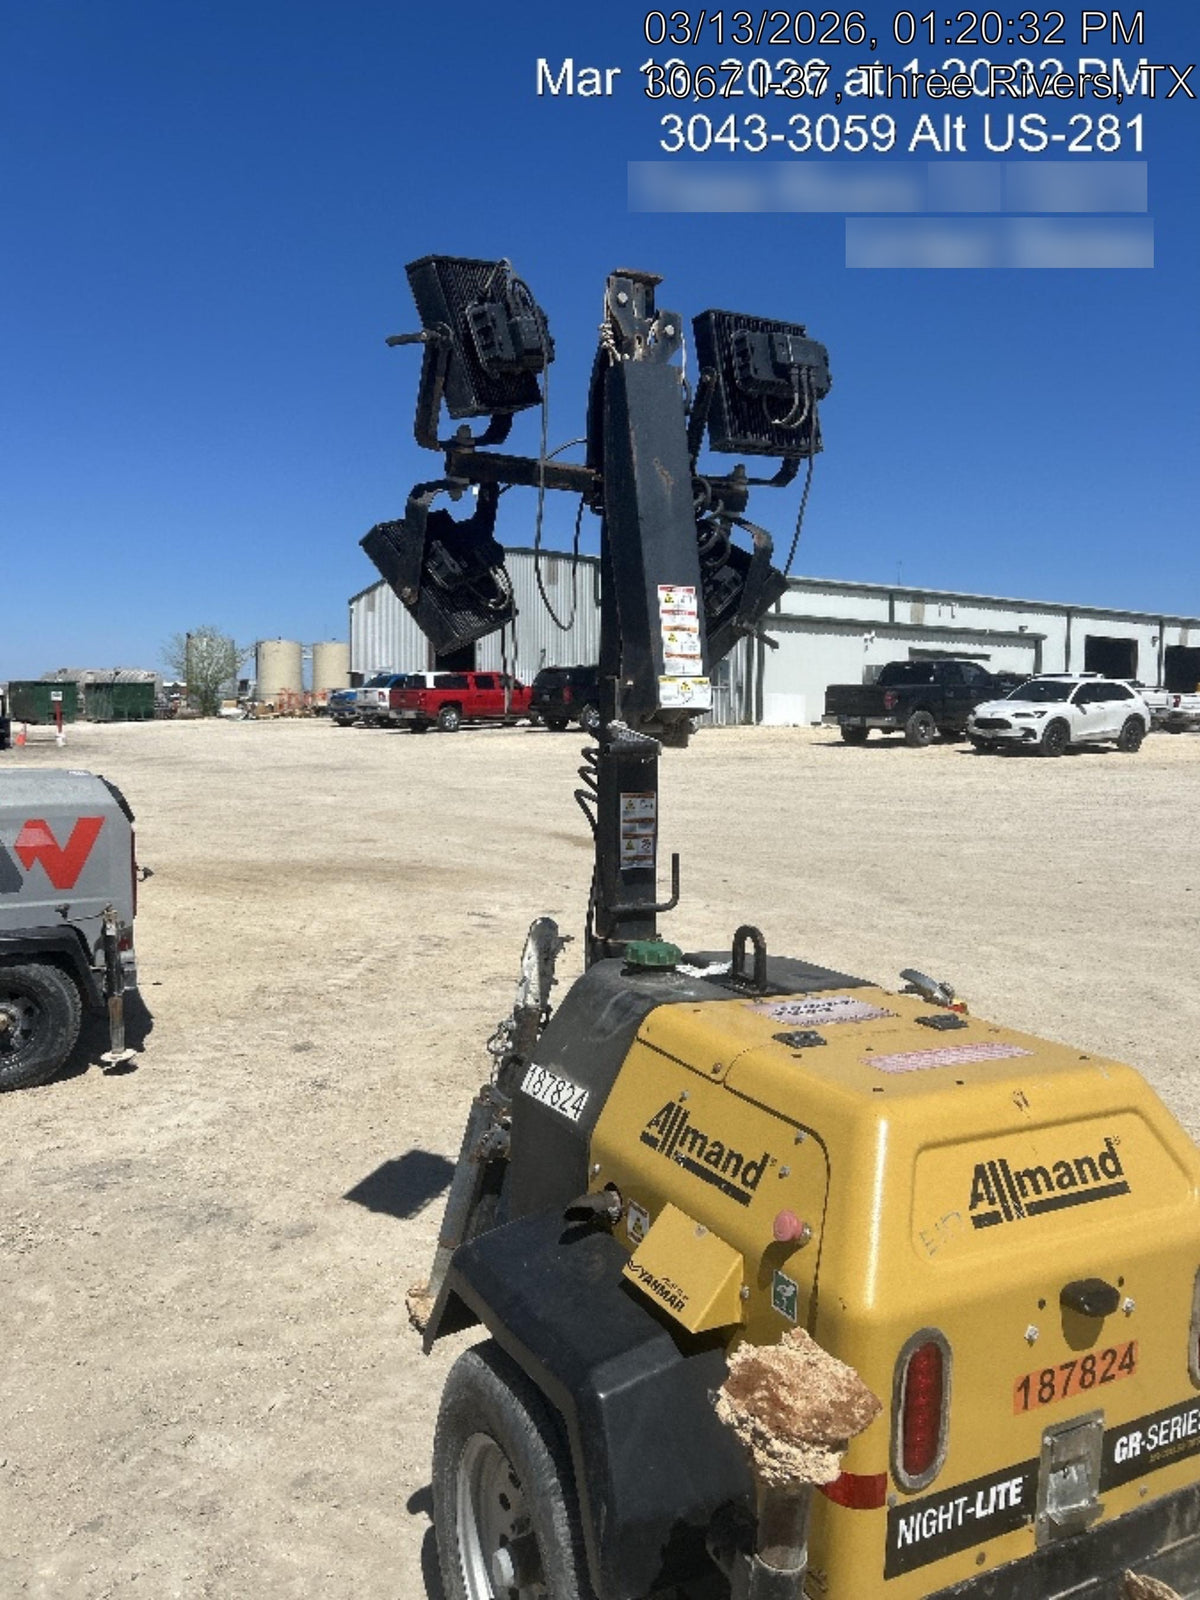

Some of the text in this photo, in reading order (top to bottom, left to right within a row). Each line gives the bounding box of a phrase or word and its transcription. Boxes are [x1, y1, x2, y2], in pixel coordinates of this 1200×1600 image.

[524, 1064, 589, 1120] 187824
[644, 1099, 771, 1193] Allmand
[968, 1136, 1125, 1223] Allmand
[638, 1267, 687, 1314] YANMAR
[1016, 1340, 1137, 1412] 187824
[896, 1476, 1025, 1550] NIGHT-LITE
